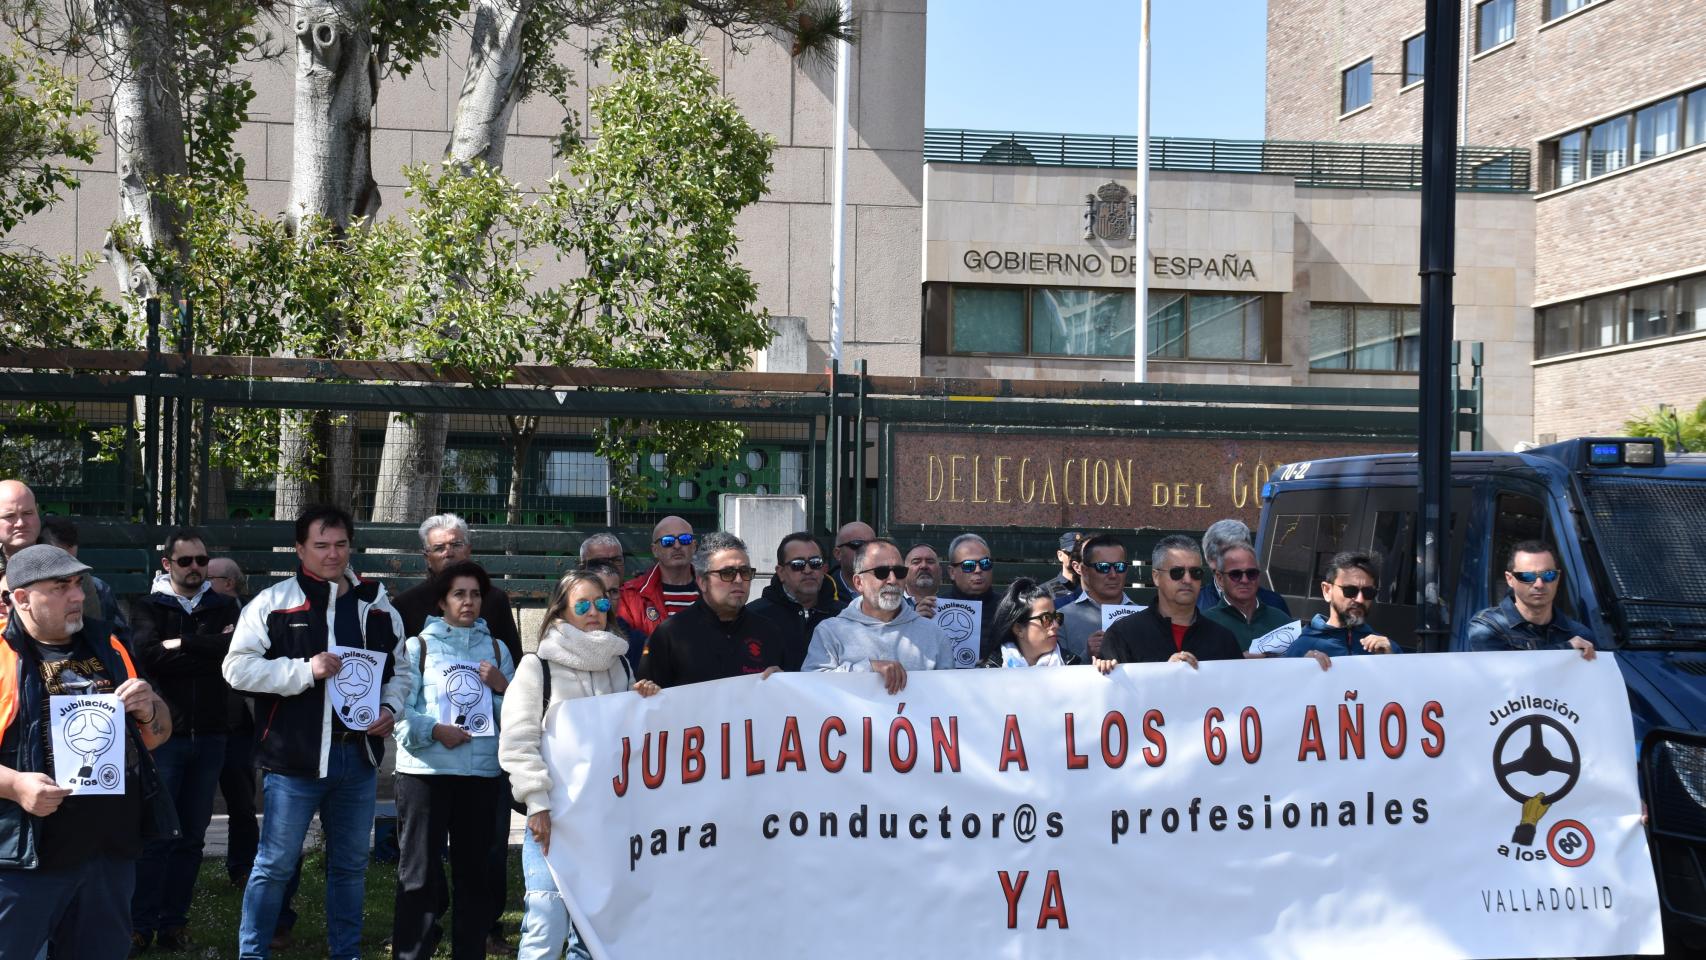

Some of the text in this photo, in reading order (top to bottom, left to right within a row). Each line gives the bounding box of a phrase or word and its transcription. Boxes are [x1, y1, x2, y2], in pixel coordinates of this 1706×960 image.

[963, 250, 1102, 274] GOBIERNO
[1154, 253, 1257, 278] ESPAÑA
[926, 454, 1281, 509] DELEGACION DEL GO
[339, 650, 378, 666] ubilación
[59, 699, 116, 717] Jubilación
[1489, 694, 1580, 727] Jubilación
[612, 689, 1446, 798] JUBILACIÓN A LOS 60 AÑOS
[80, 778, 98, 787] los
[630, 791, 1430, 872] para conductor@s profesionales
[1497, 831, 1583, 862] a los 60
[997, 869, 1069, 929] YA
[1481, 885, 1614, 913] VALLADOLID
